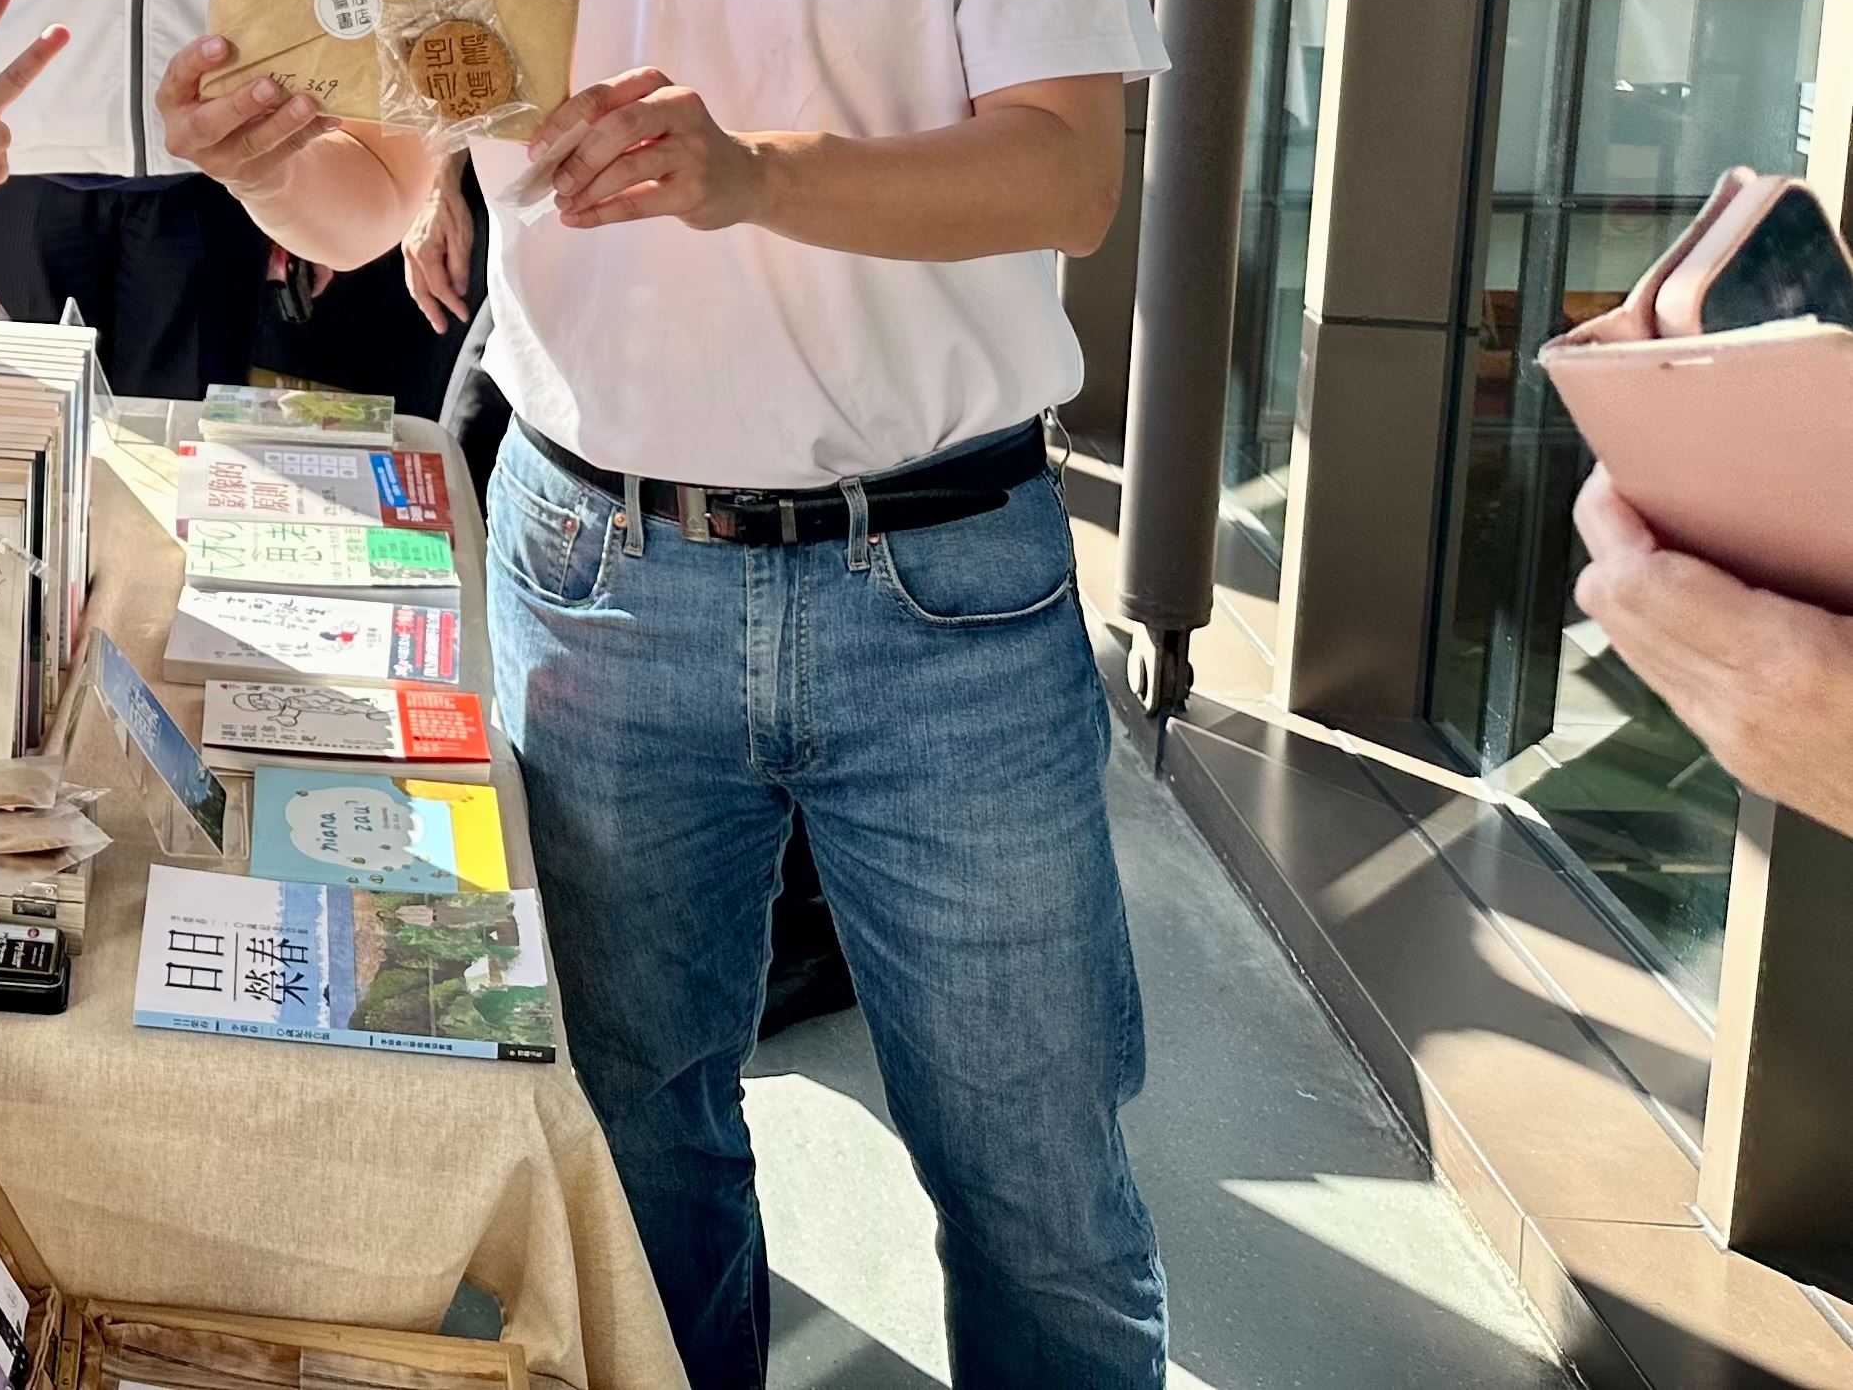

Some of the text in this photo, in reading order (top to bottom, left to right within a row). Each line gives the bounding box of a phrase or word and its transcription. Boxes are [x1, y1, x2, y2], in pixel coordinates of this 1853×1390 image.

[304, 79, 339, 99] 369
[208, 462, 247, 509] 影像的
[252, 482, 290, 513] 原則
[244, 937, 309, 1006] 榮春
